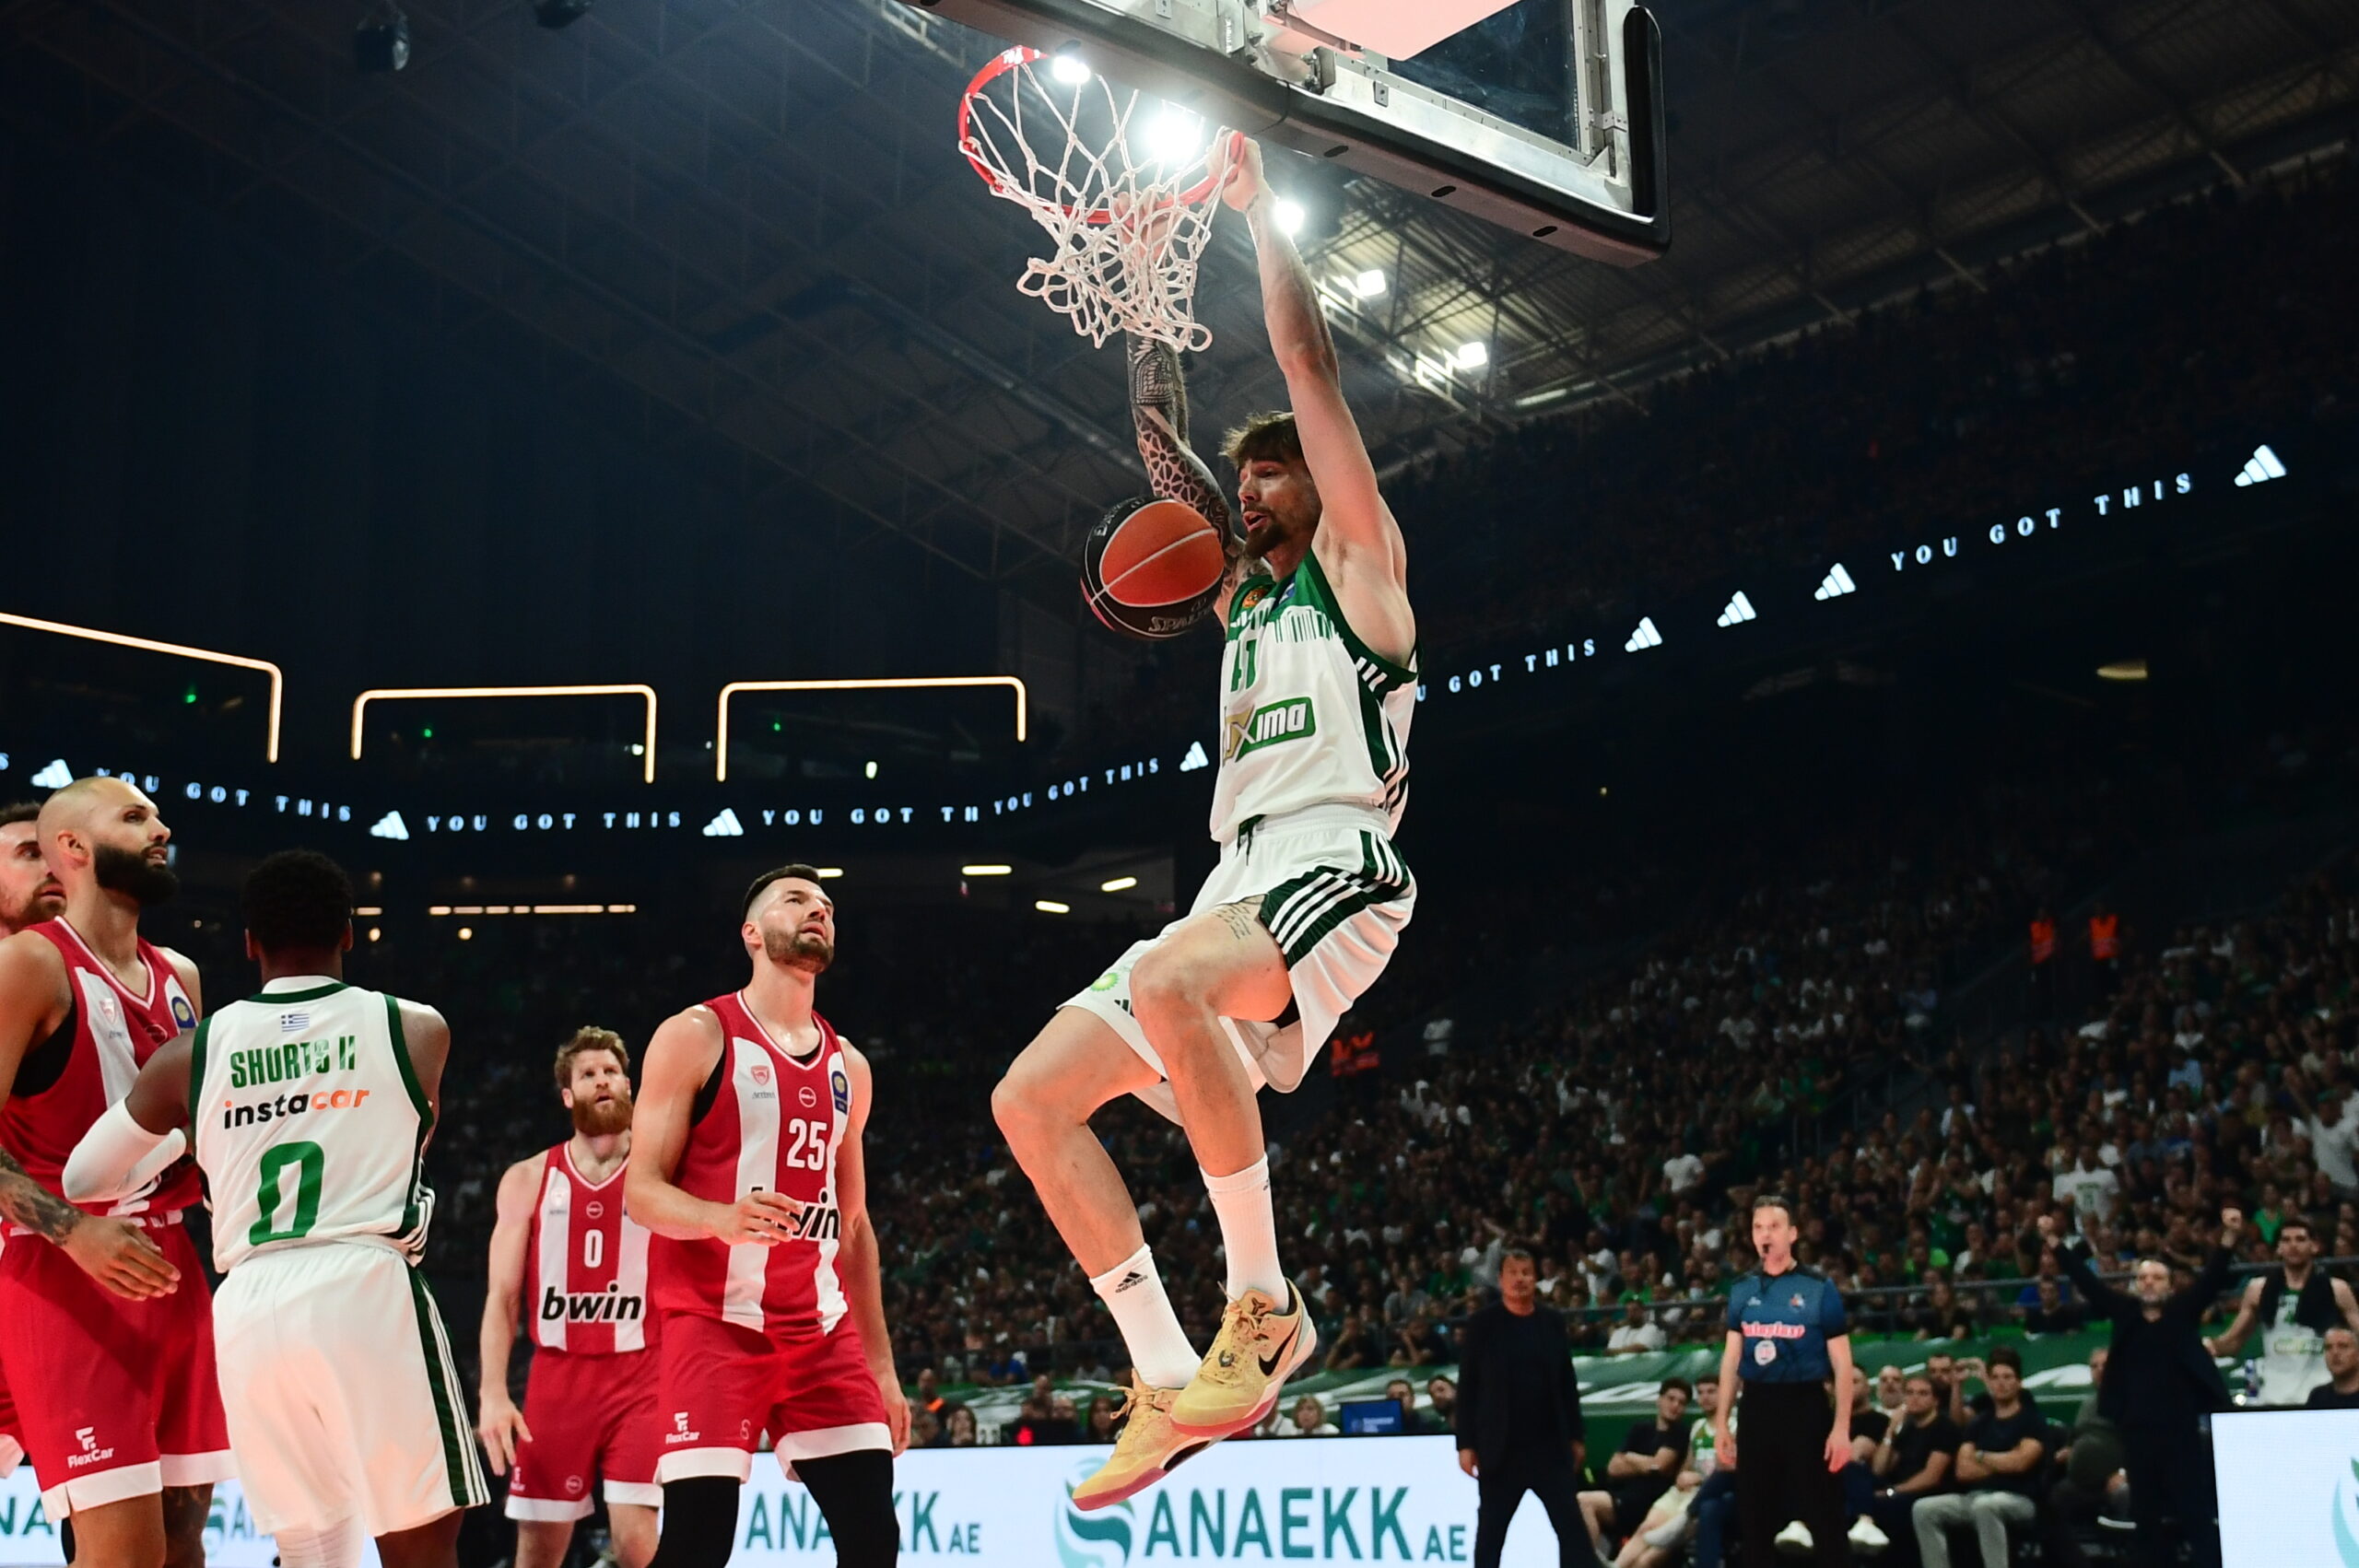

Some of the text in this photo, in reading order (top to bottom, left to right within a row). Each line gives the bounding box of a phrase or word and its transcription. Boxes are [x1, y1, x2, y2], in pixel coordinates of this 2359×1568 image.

[1891, 474, 2191, 571] YOU GOT THIS
[1449, 638, 1595, 693] GOT THIS
[186, 782, 250, 806] GOT
[276, 795, 350, 822] THIS
[994, 757, 1159, 814] YOU GOT THIS
[427, 812, 681, 832] YOU GOT THIS
[763, 809, 823, 825] YOU
[851, 807, 913, 824] GOT
[230, 1038, 331, 1089] SHORTS
[224, 1089, 370, 1129] instacar
[786, 1117, 827, 1171] 25
[249, 1141, 324, 1246] 0
[751, 1186, 839, 1240] win
[584, 1229, 604, 1269] 0
[541, 1281, 642, 1320] bwin
[1115, 1275, 1148, 1293] adidas
[67, 1447, 114, 1469] FlexCar
[949, 1523, 980, 1553] AE
[1144, 1486, 1468, 1562] ANAEKK AE
